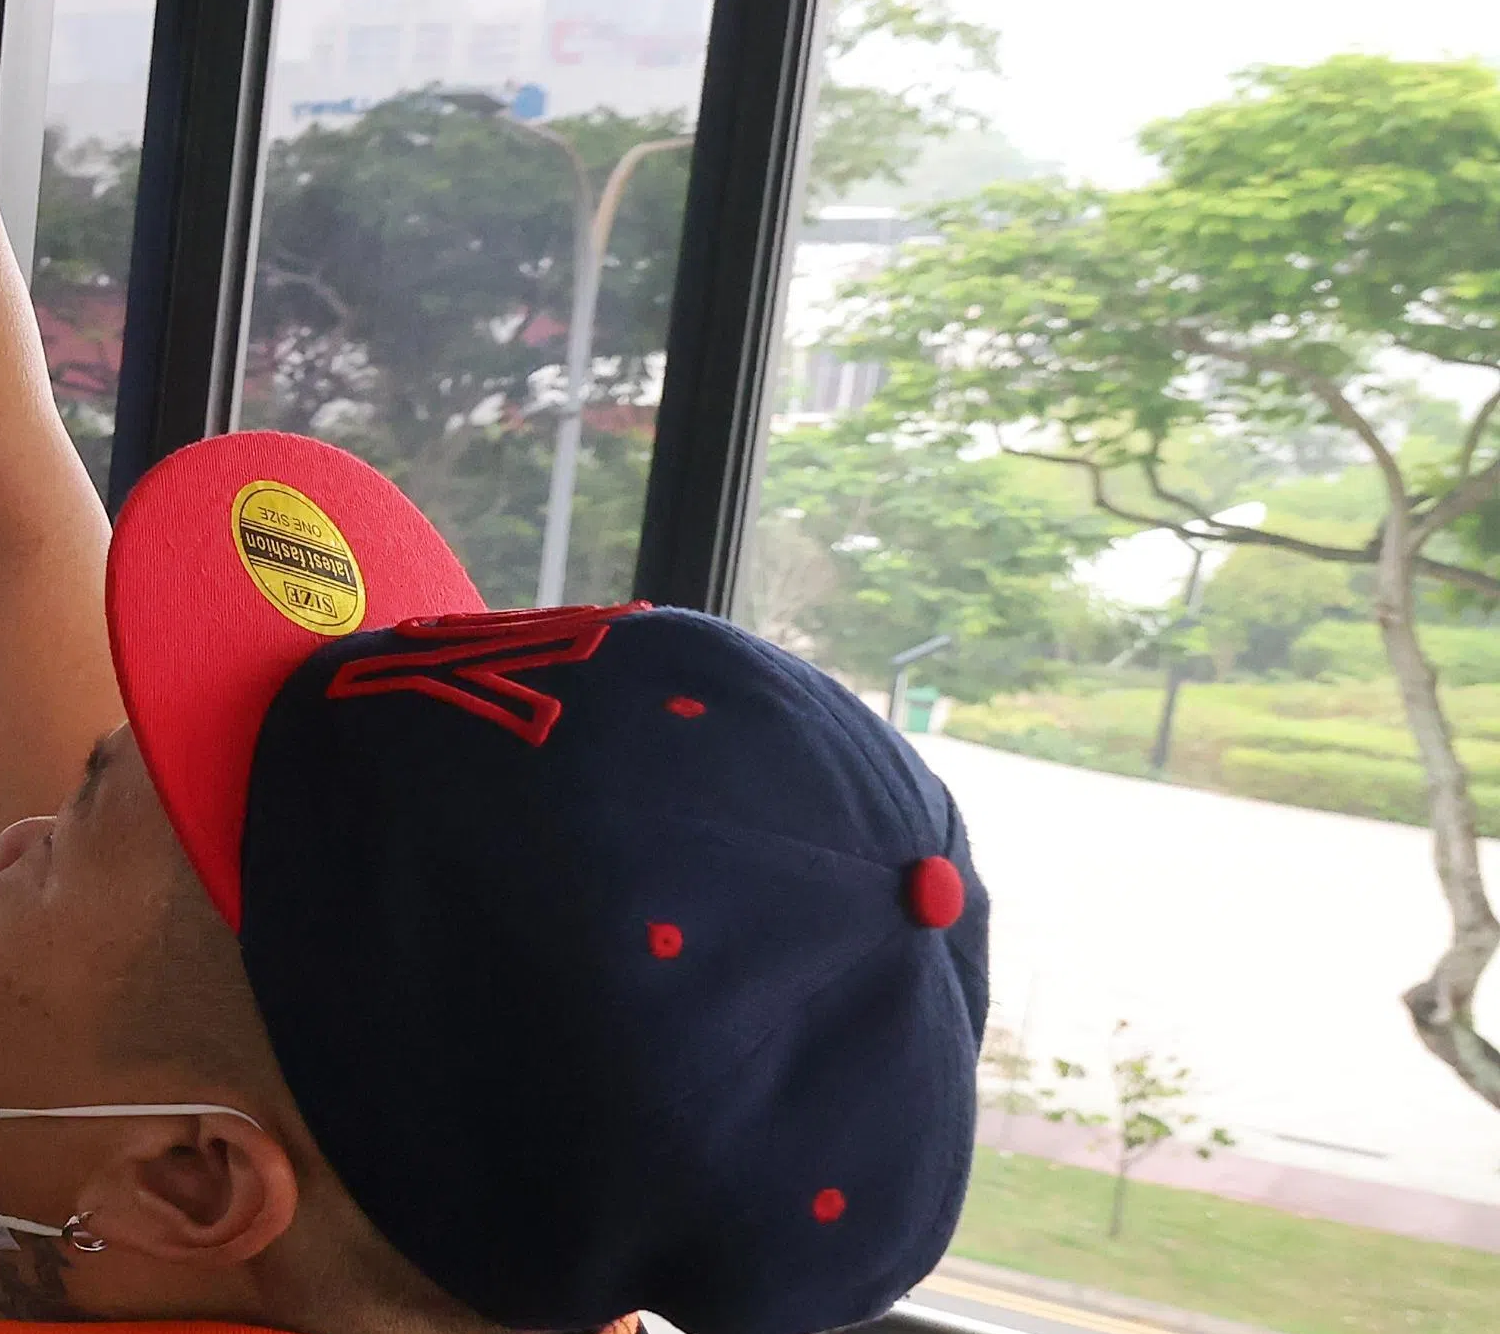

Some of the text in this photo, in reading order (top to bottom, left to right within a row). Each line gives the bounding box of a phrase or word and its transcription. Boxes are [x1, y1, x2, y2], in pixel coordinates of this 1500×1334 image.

[257, 506, 322, 538] ONE SIZE
[289, 586, 333, 614] SIZE
